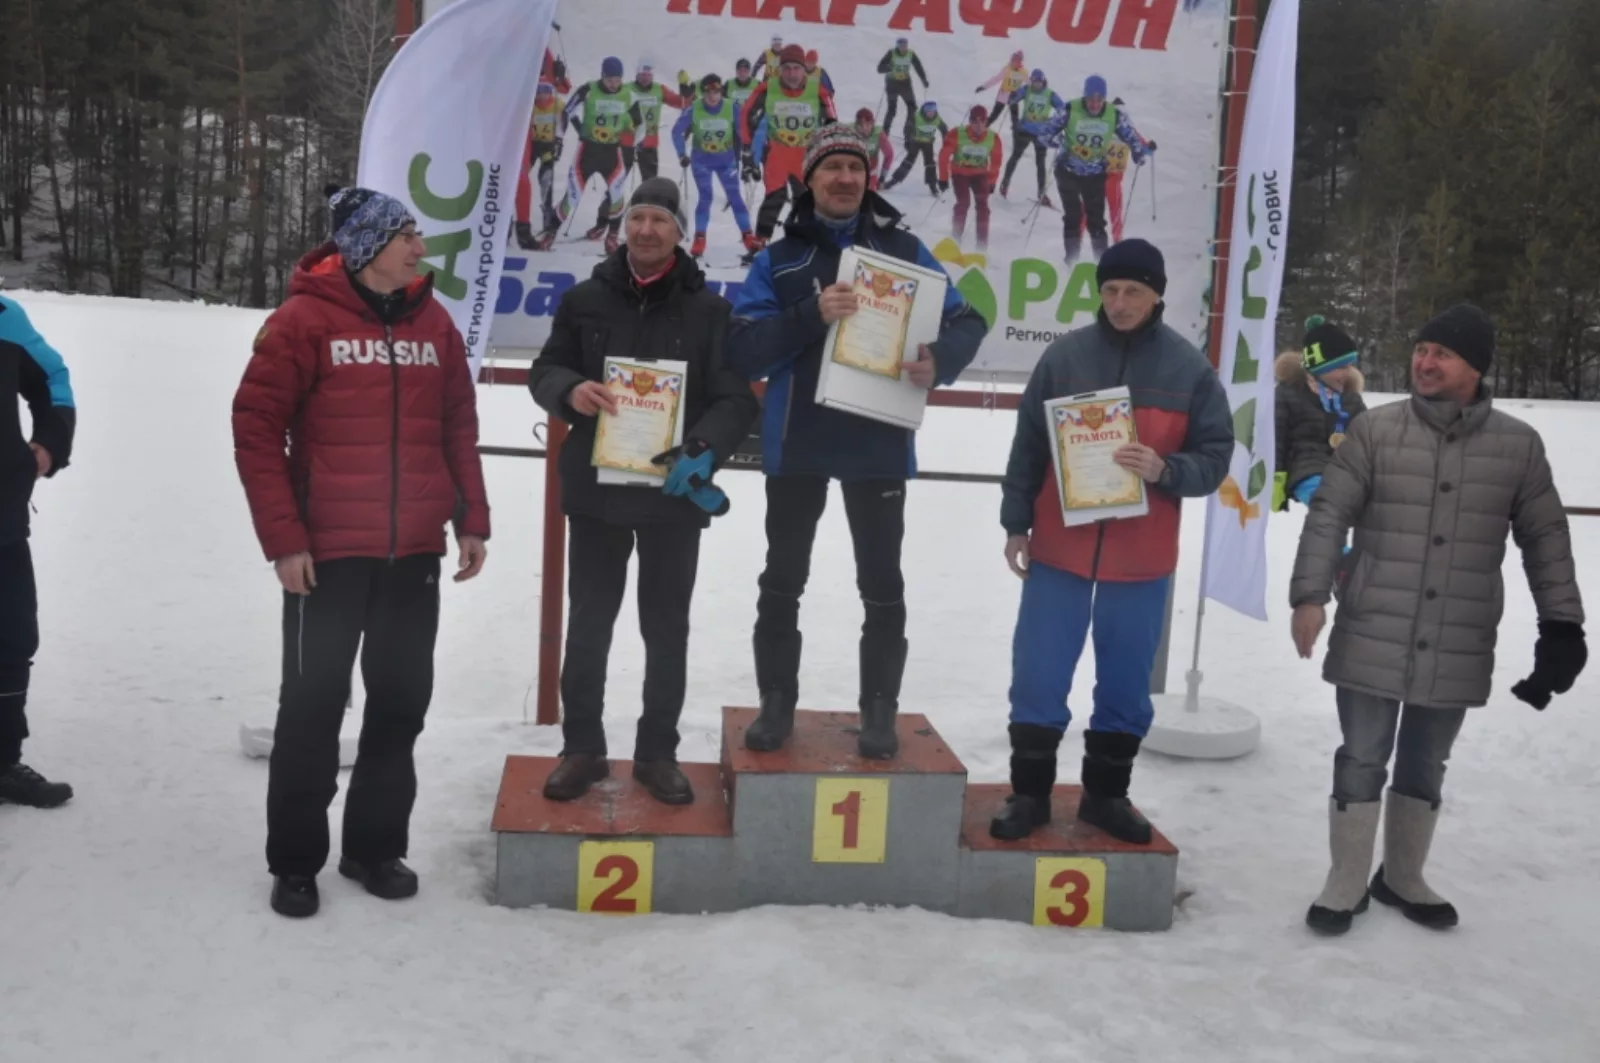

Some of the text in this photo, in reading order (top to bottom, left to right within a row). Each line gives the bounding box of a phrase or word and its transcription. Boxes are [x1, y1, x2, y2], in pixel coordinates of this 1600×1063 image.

[666, 0, 1179, 51] АФОН
[330, 339, 440, 367] RUSSIA
[1069, 429, 1124, 445] ГРАМОТА
[831, 790, 861, 849] 1
[590, 854, 639, 913] 2
[1046, 868, 1091, 927] 3
